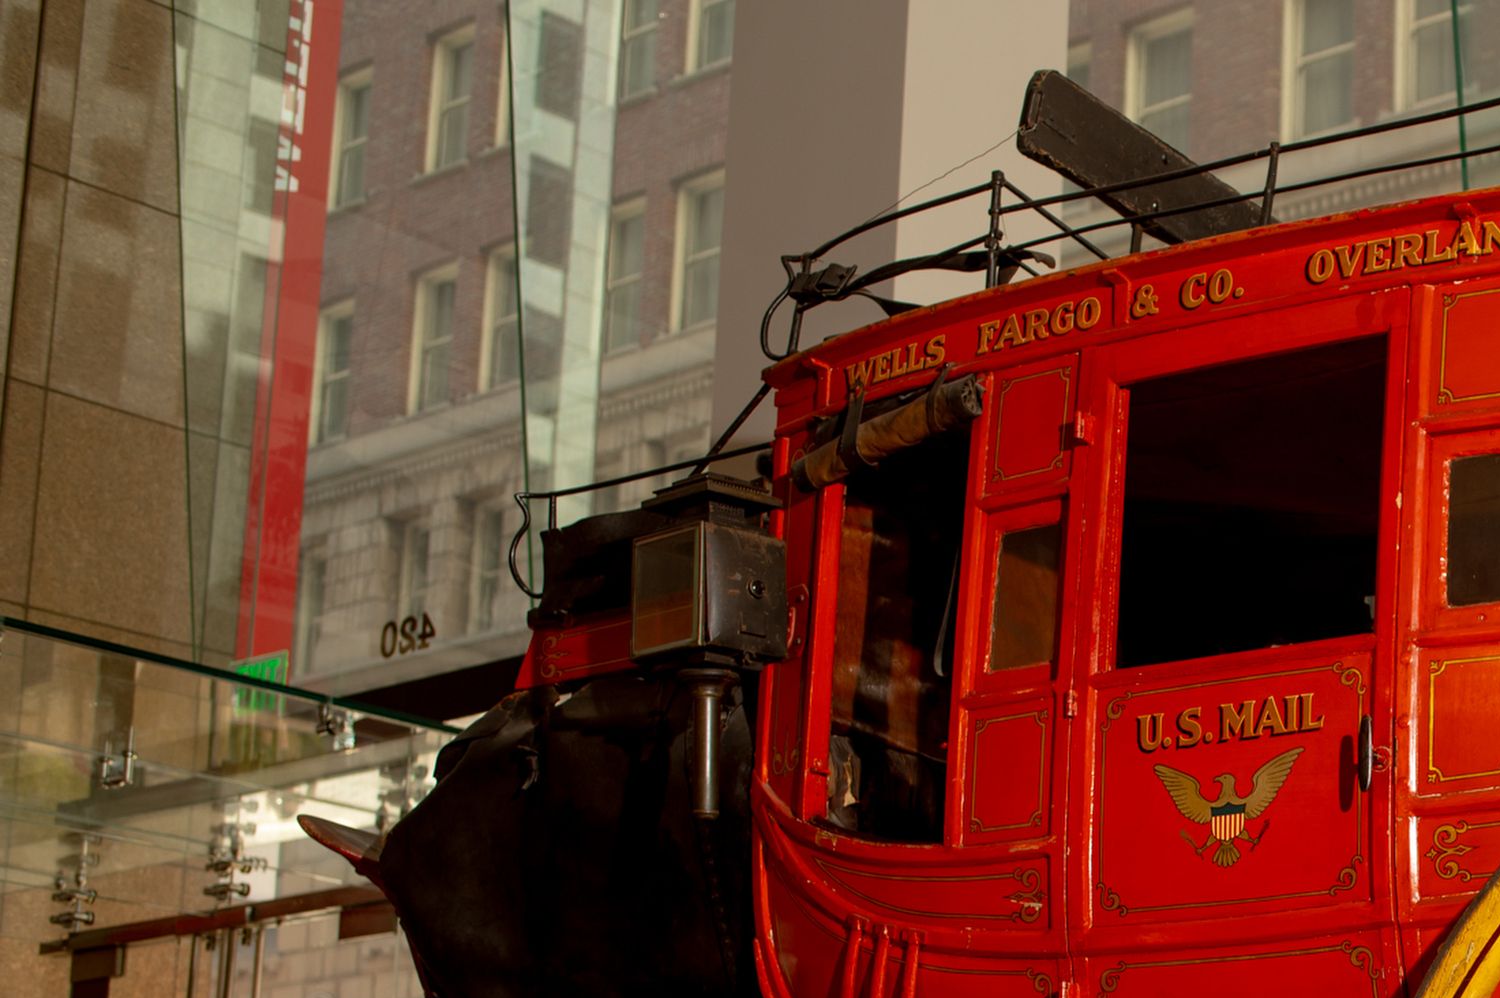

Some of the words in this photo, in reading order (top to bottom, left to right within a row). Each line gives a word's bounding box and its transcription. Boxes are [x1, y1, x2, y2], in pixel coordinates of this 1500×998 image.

[845, 334, 946, 391] WELLS
[976, 296, 1101, 356] FARGO
[1131, 284, 1160, 319] &
[1180, 268, 1245, 310] CO.
[236, 657, 281, 717] EXIT
[1136, 706, 1214, 753] U.S.
[1219, 692, 1326, 744] MAIL
